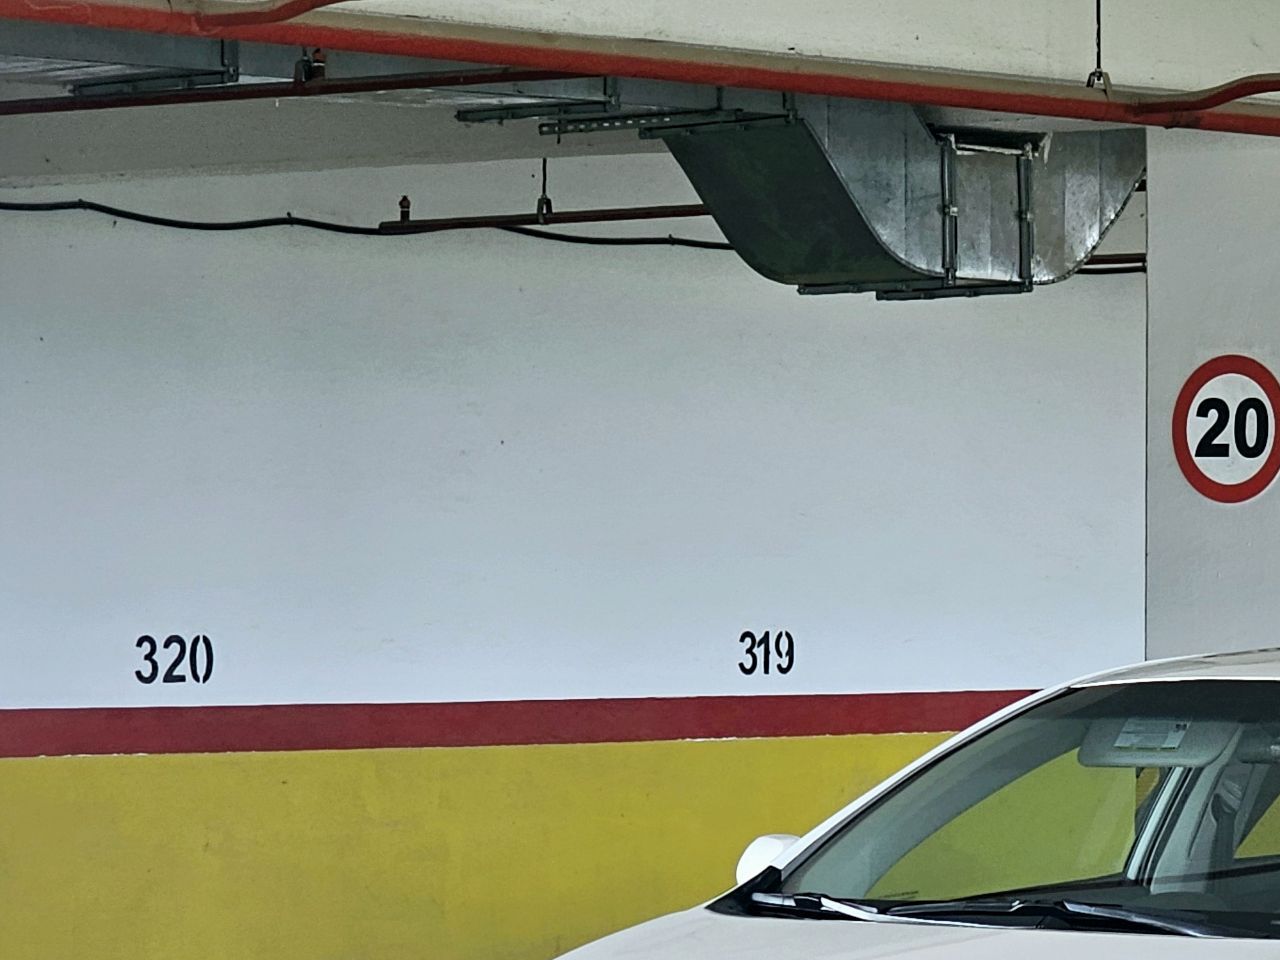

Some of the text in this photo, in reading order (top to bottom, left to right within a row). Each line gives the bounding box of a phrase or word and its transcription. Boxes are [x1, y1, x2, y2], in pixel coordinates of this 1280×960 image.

[1194, 397, 1269, 459] 20
[135, 635, 213, 684] 320
[739, 631, 794, 675] 319
